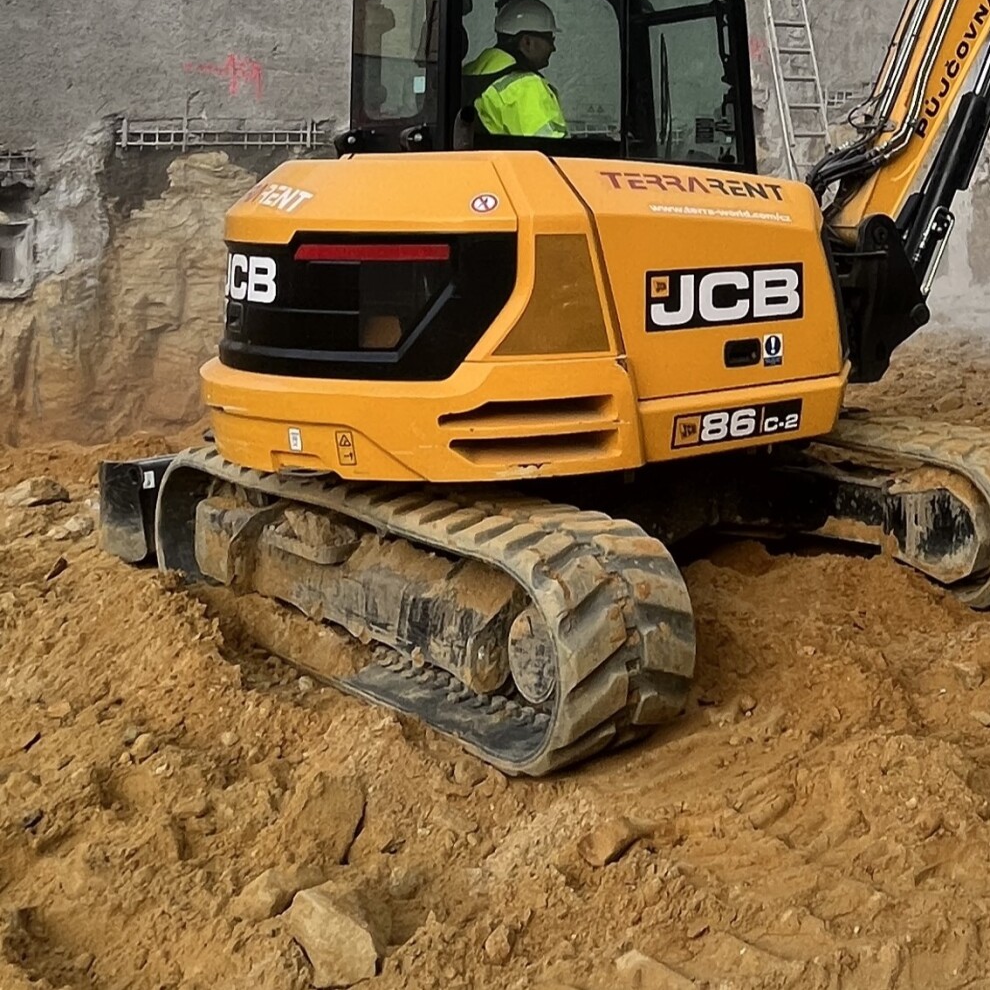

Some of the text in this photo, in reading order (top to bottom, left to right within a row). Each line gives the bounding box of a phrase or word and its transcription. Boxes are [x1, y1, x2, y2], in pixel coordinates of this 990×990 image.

[600, 171, 783, 202] TERRARENT
[650, 268, 801, 326] JCB
[700, 408, 756, 442] 86
